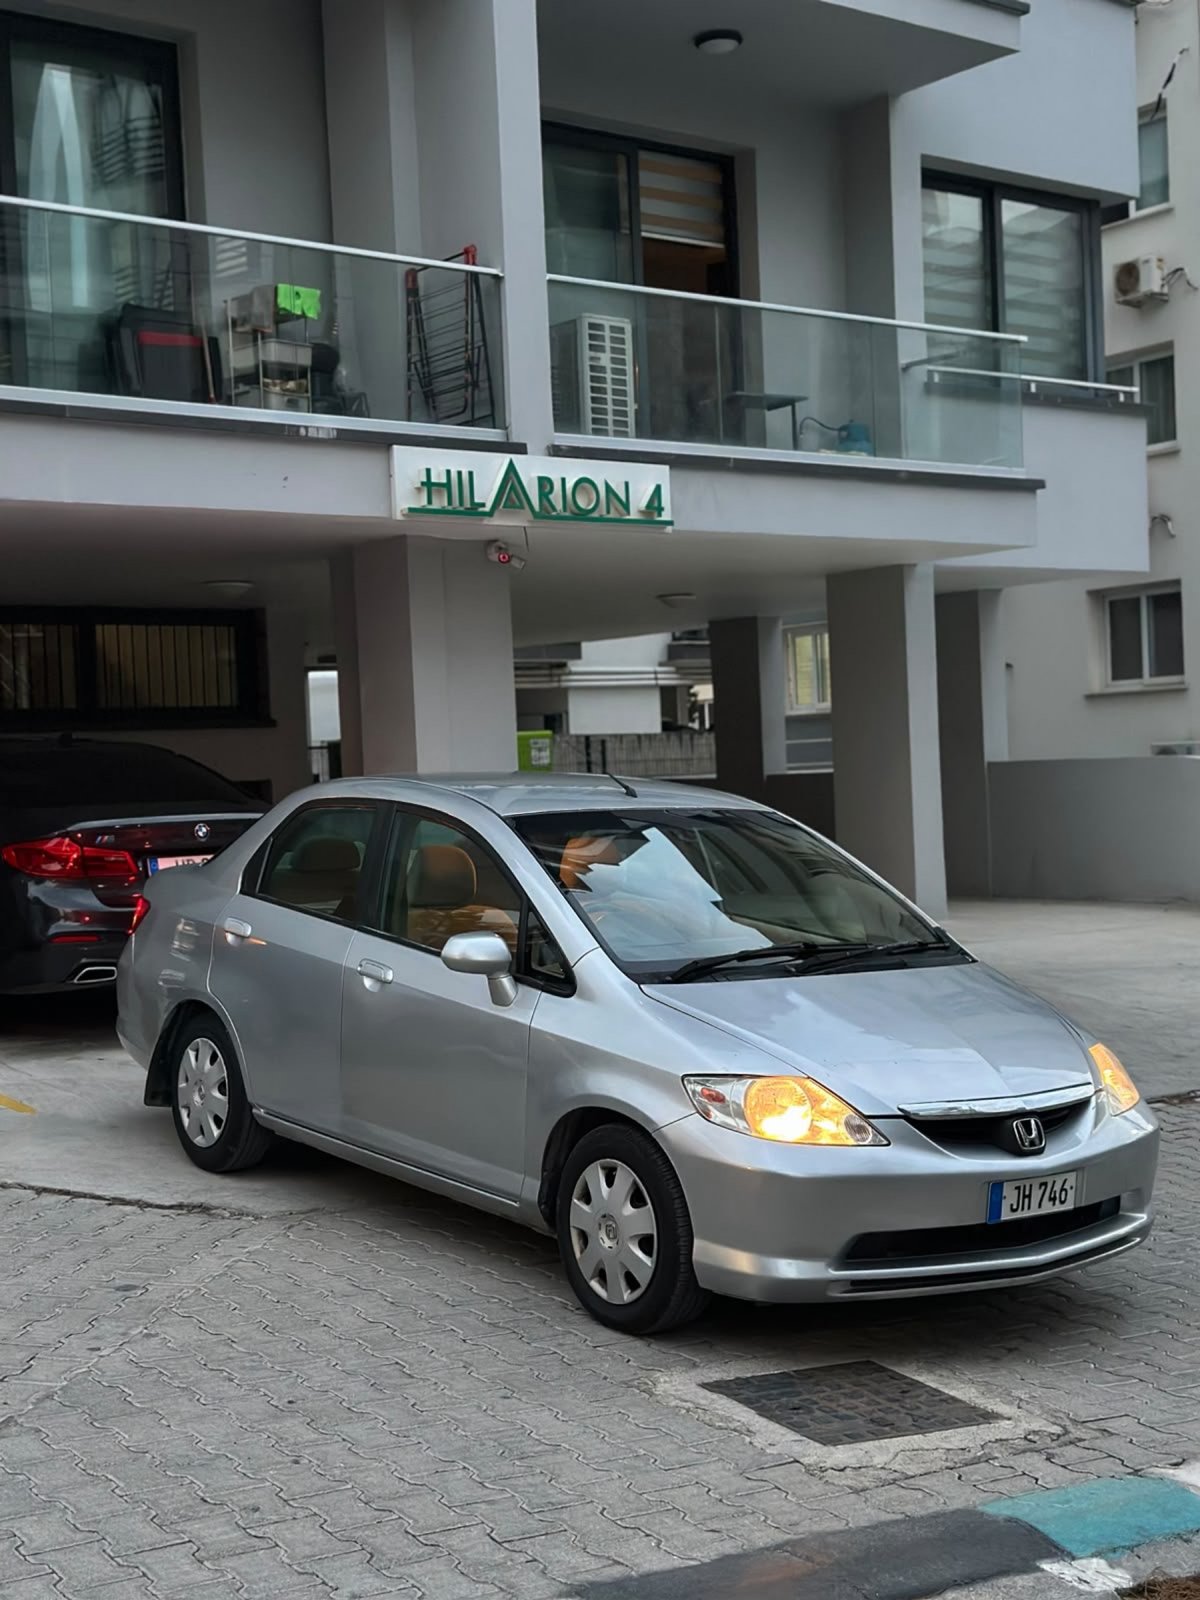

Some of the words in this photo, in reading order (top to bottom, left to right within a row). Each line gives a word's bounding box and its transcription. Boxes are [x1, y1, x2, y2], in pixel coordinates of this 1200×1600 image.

[420, 458, 631, 518] HILARION
[643, 483, 665, 518] 4
[1009, 1183, 1033, 1213] JH
[1037, 1178, 1069, 1210] 746
